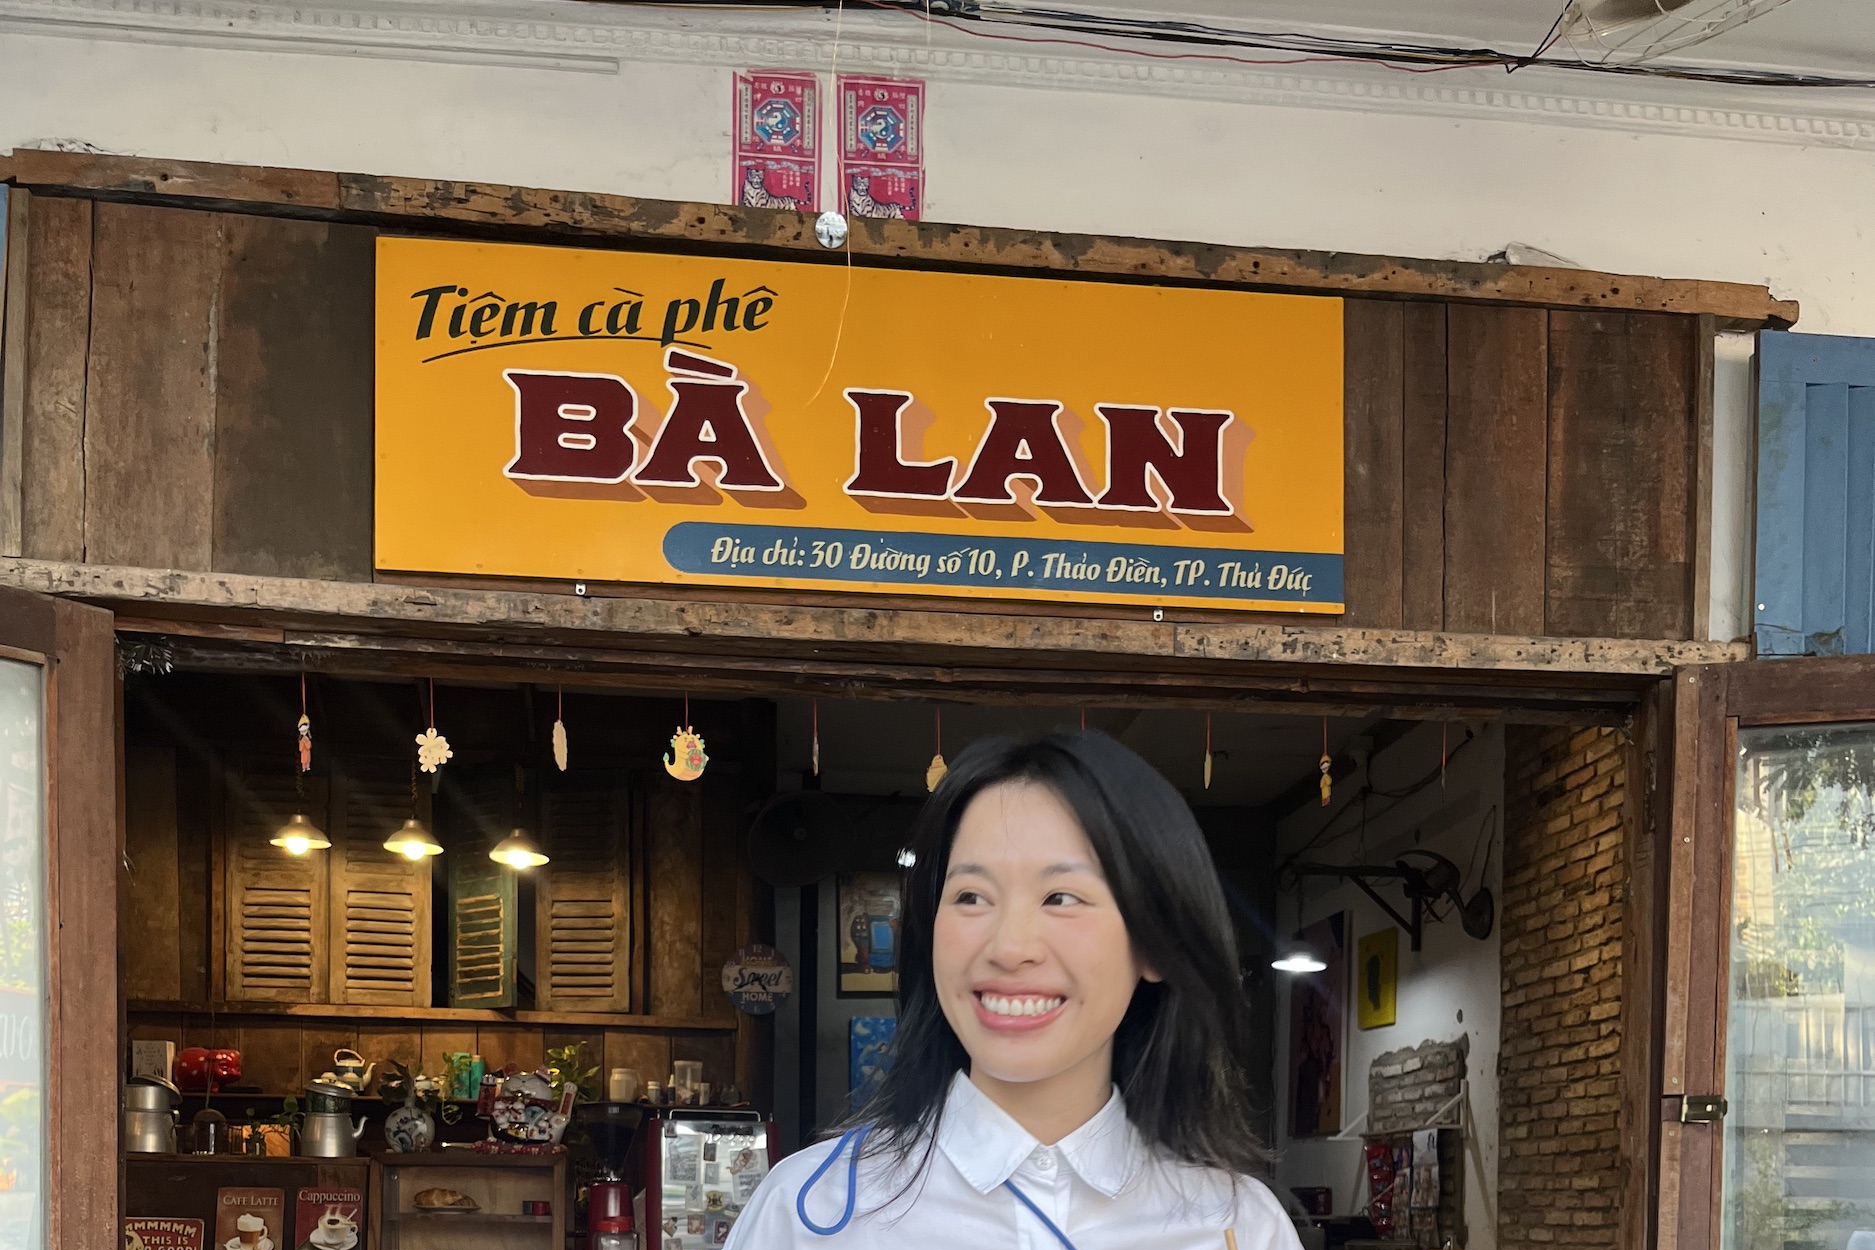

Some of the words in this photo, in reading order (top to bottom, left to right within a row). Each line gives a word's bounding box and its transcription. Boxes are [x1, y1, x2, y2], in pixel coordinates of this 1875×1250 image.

[410, 284, 558, 345] Tiệm
[578, 287, 645, 337] cà
[660, 278, 779, 348] phê
[503, 346, 785, 492] BÀ
[842, 387, 1235, 516] LAN
[710, 536, 755, 568] Địa
[762, 536, 805, 567] chỉ:
[809, 541, 843, 568] 30
[848, 542, 932, 578] Đường
[936, 547, 971, 574] số
[967, 549, 1003, 579] 10,
[1010, 550, 1034, 578] P.
[1041, 552, 1101, 581] Thảo
[1106, 556, 1168, 588] Điền,
[1173, 559, 1211, 587] TP.
[1217, 562, 1262, 589] Thủ
[1266, 564, 1313, 597] Đức
[742, 991, 774, 1002] HOME
[223, 1194, 249, 1206] CAFE
[250, 1194, 279, 1206] LATTE
[299, 1189, 361, 1204] Cappuccino
[142, 1235, 172, 1245] THIS
[177, 1235, 188, 1245] IS
